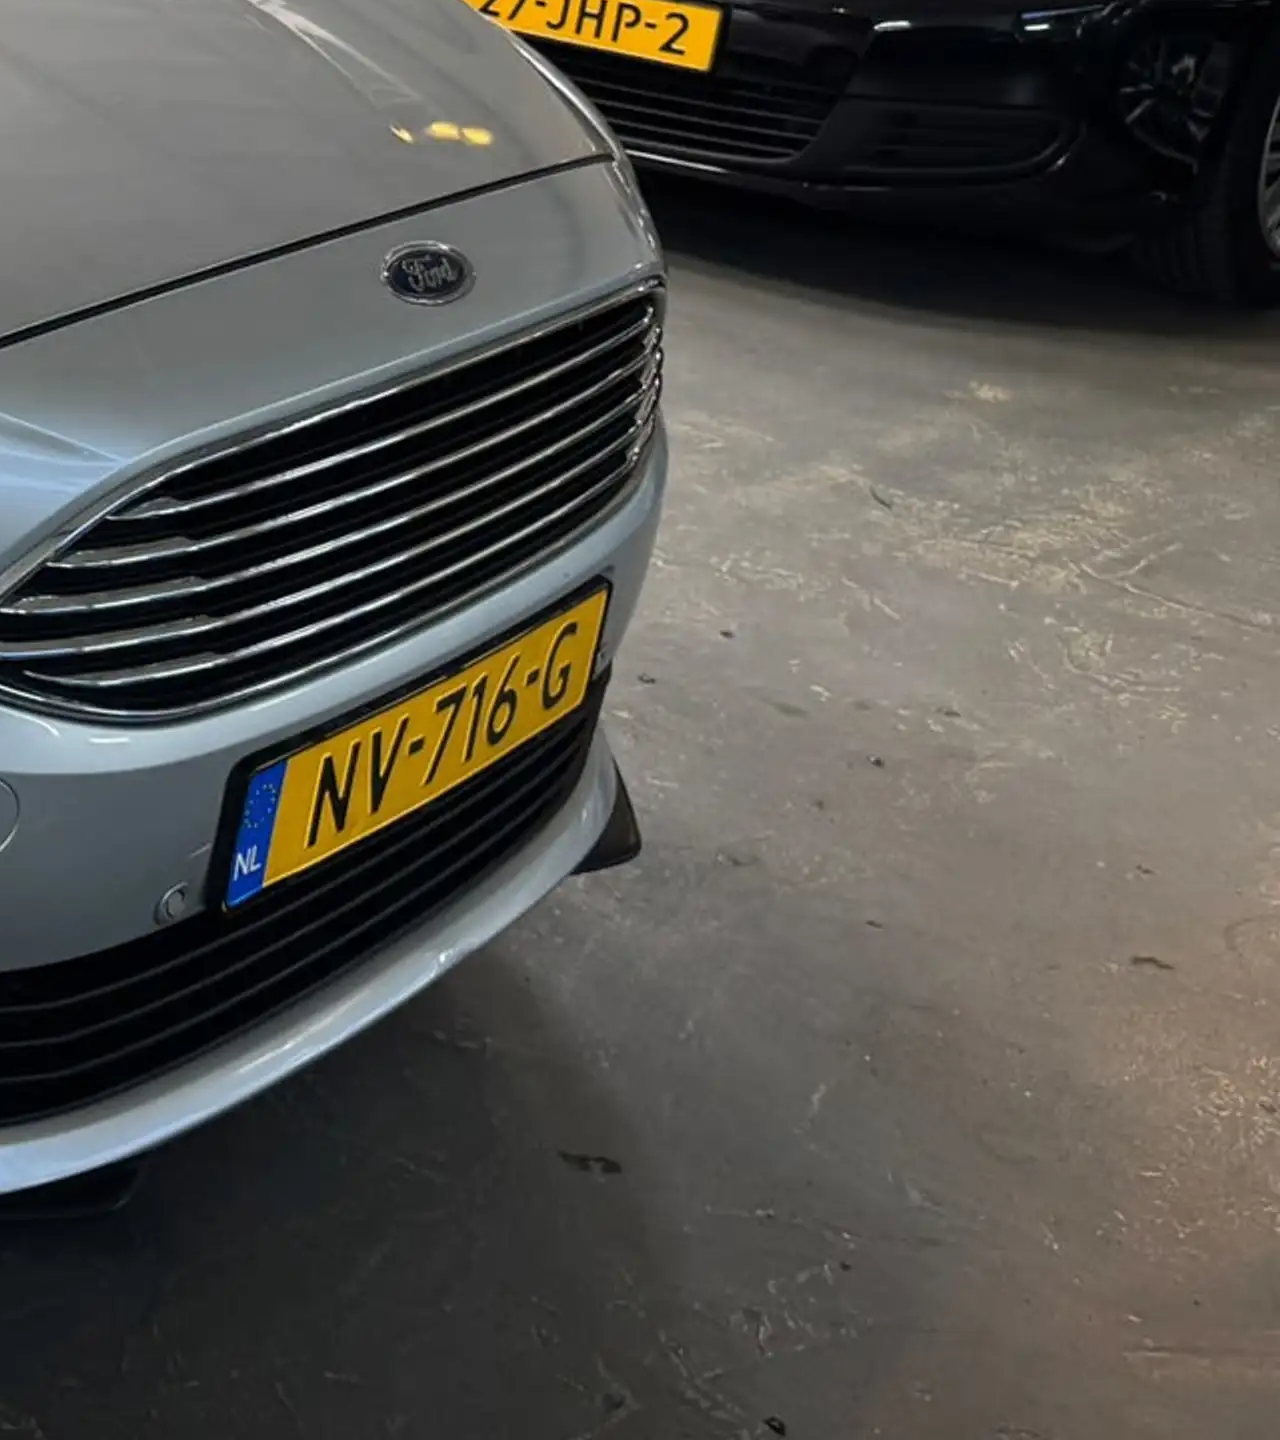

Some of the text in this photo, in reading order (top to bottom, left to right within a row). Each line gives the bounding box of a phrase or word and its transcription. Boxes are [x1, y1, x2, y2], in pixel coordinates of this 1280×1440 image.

[401, 254, 458, 292] Ford
[303, 620, 580, 850] NV-716-G
[231, 844, 262, 882] NL
